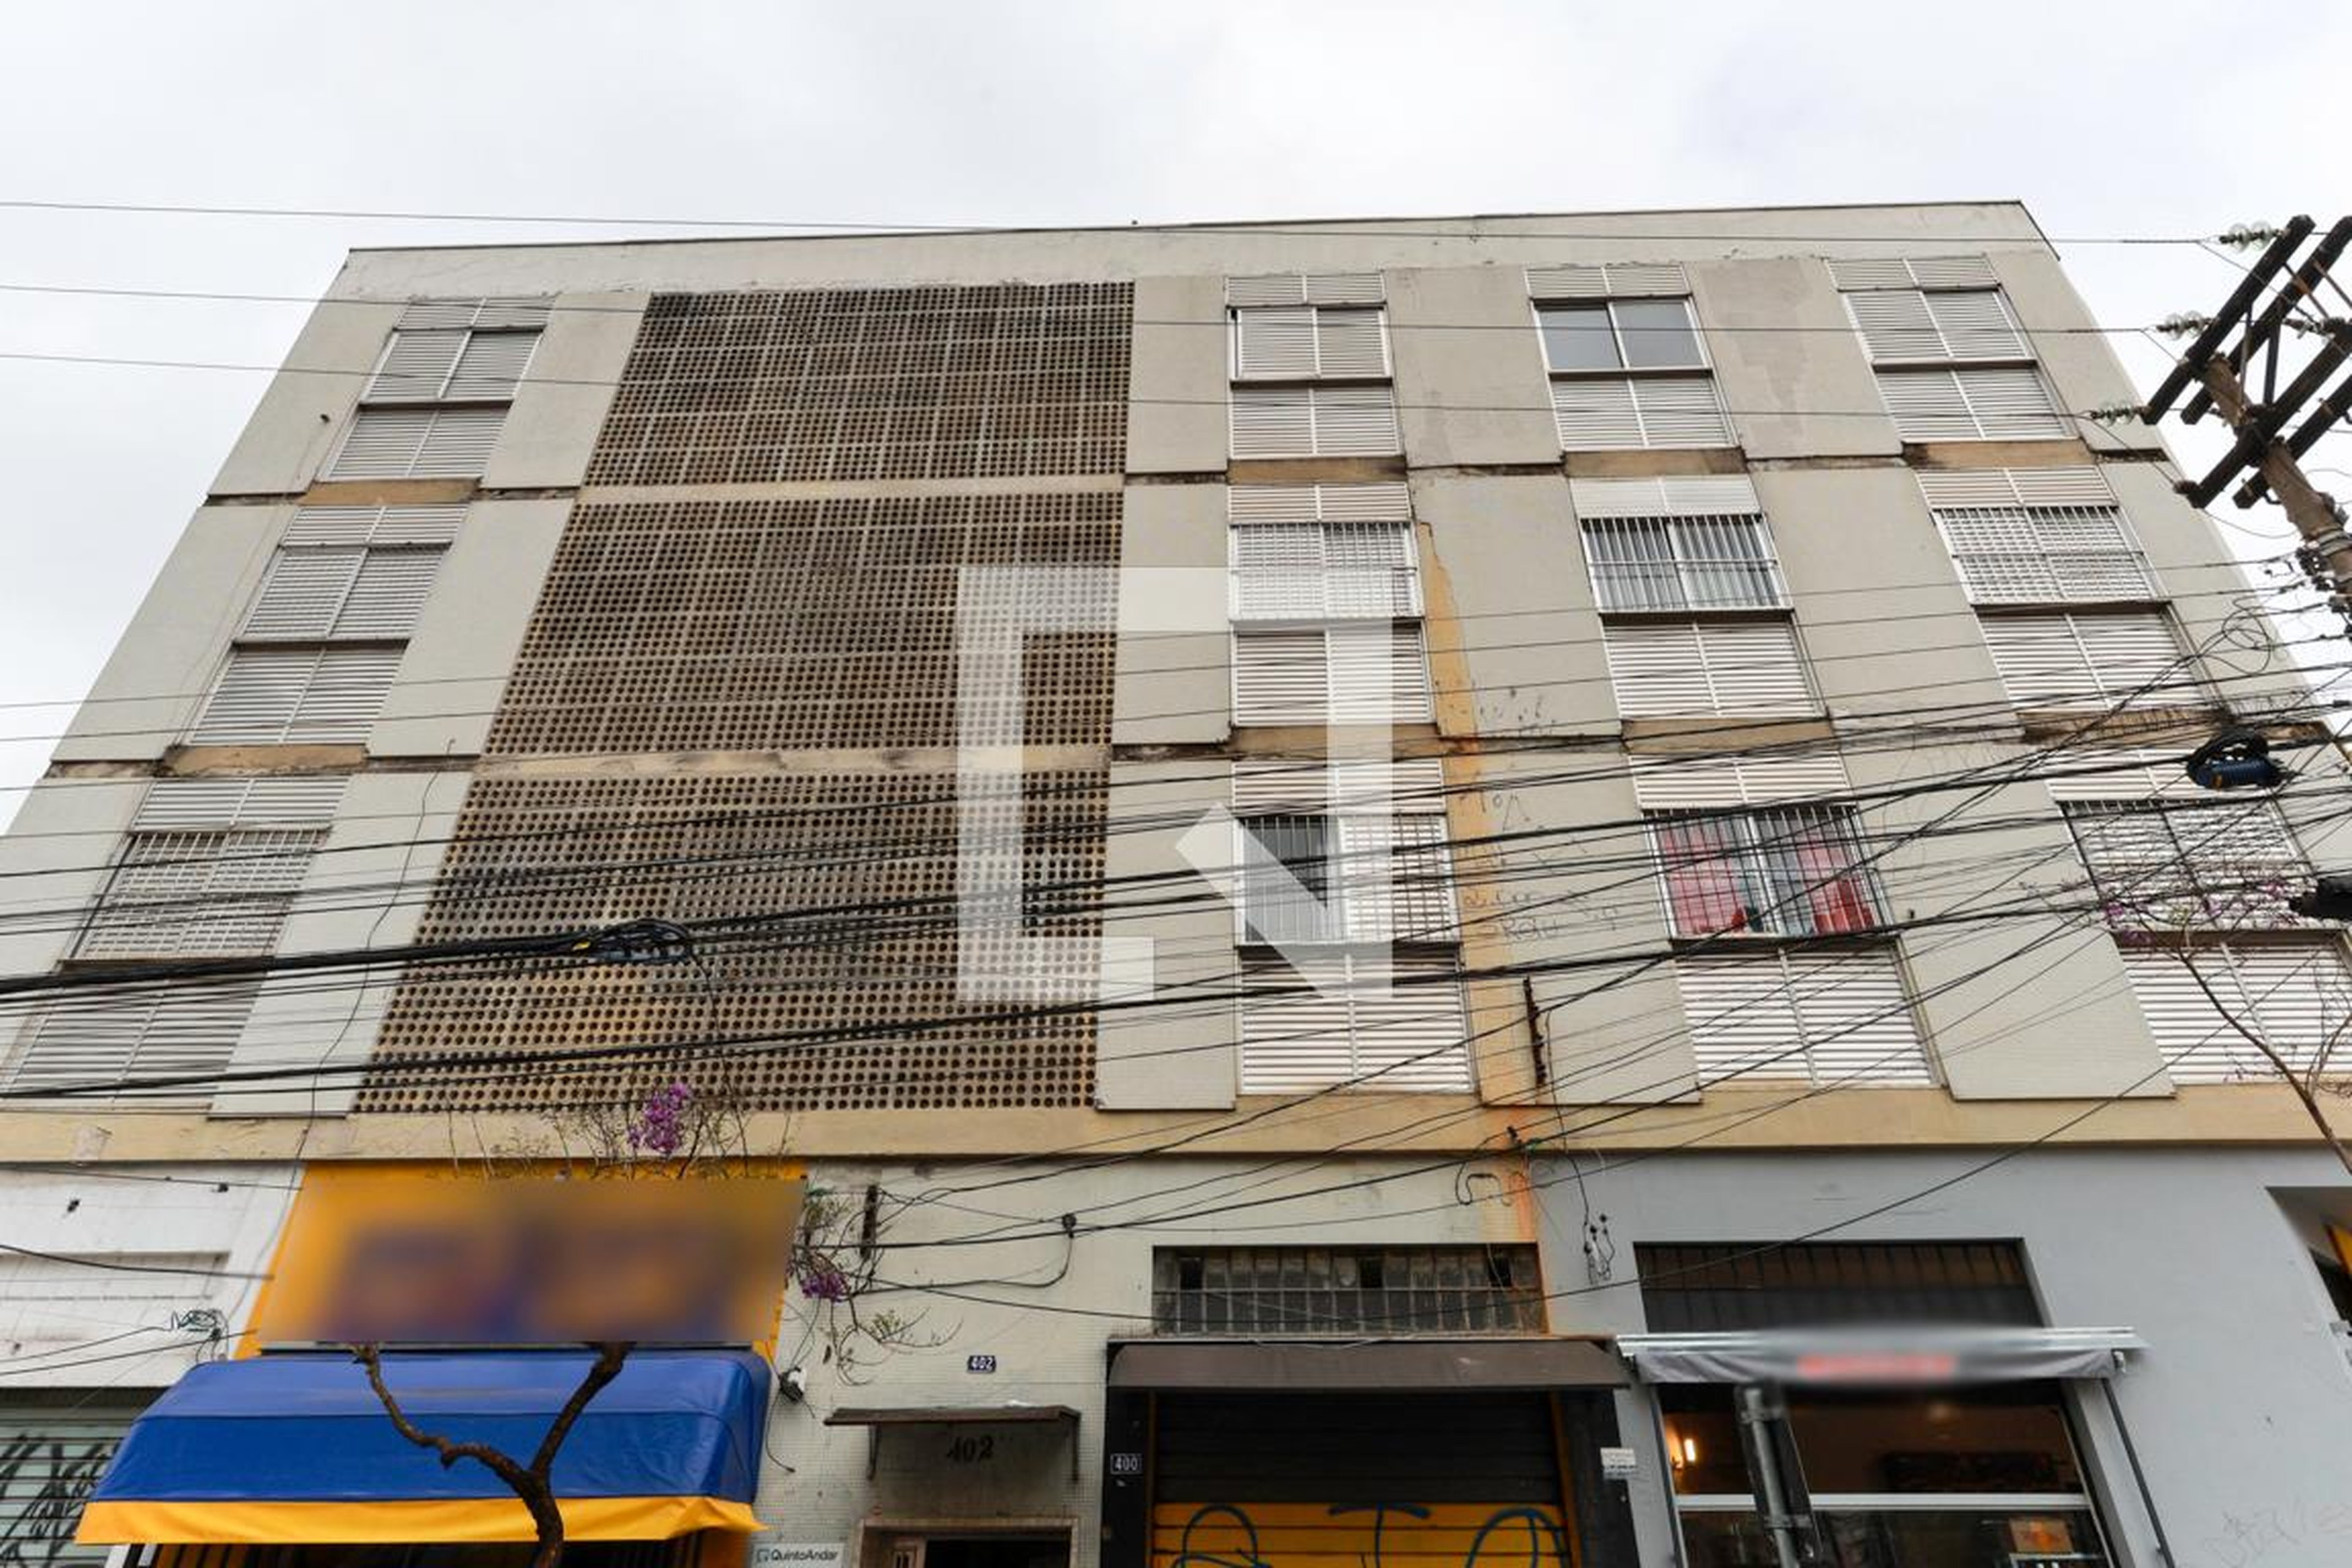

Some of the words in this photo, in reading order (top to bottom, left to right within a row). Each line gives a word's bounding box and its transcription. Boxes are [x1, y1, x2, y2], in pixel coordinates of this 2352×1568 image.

[946, 1434, 993, 1463] 402
[1115, 1457, 1138, 1471] 400
[771, 1549, 839, 1561] QuintoAndar
